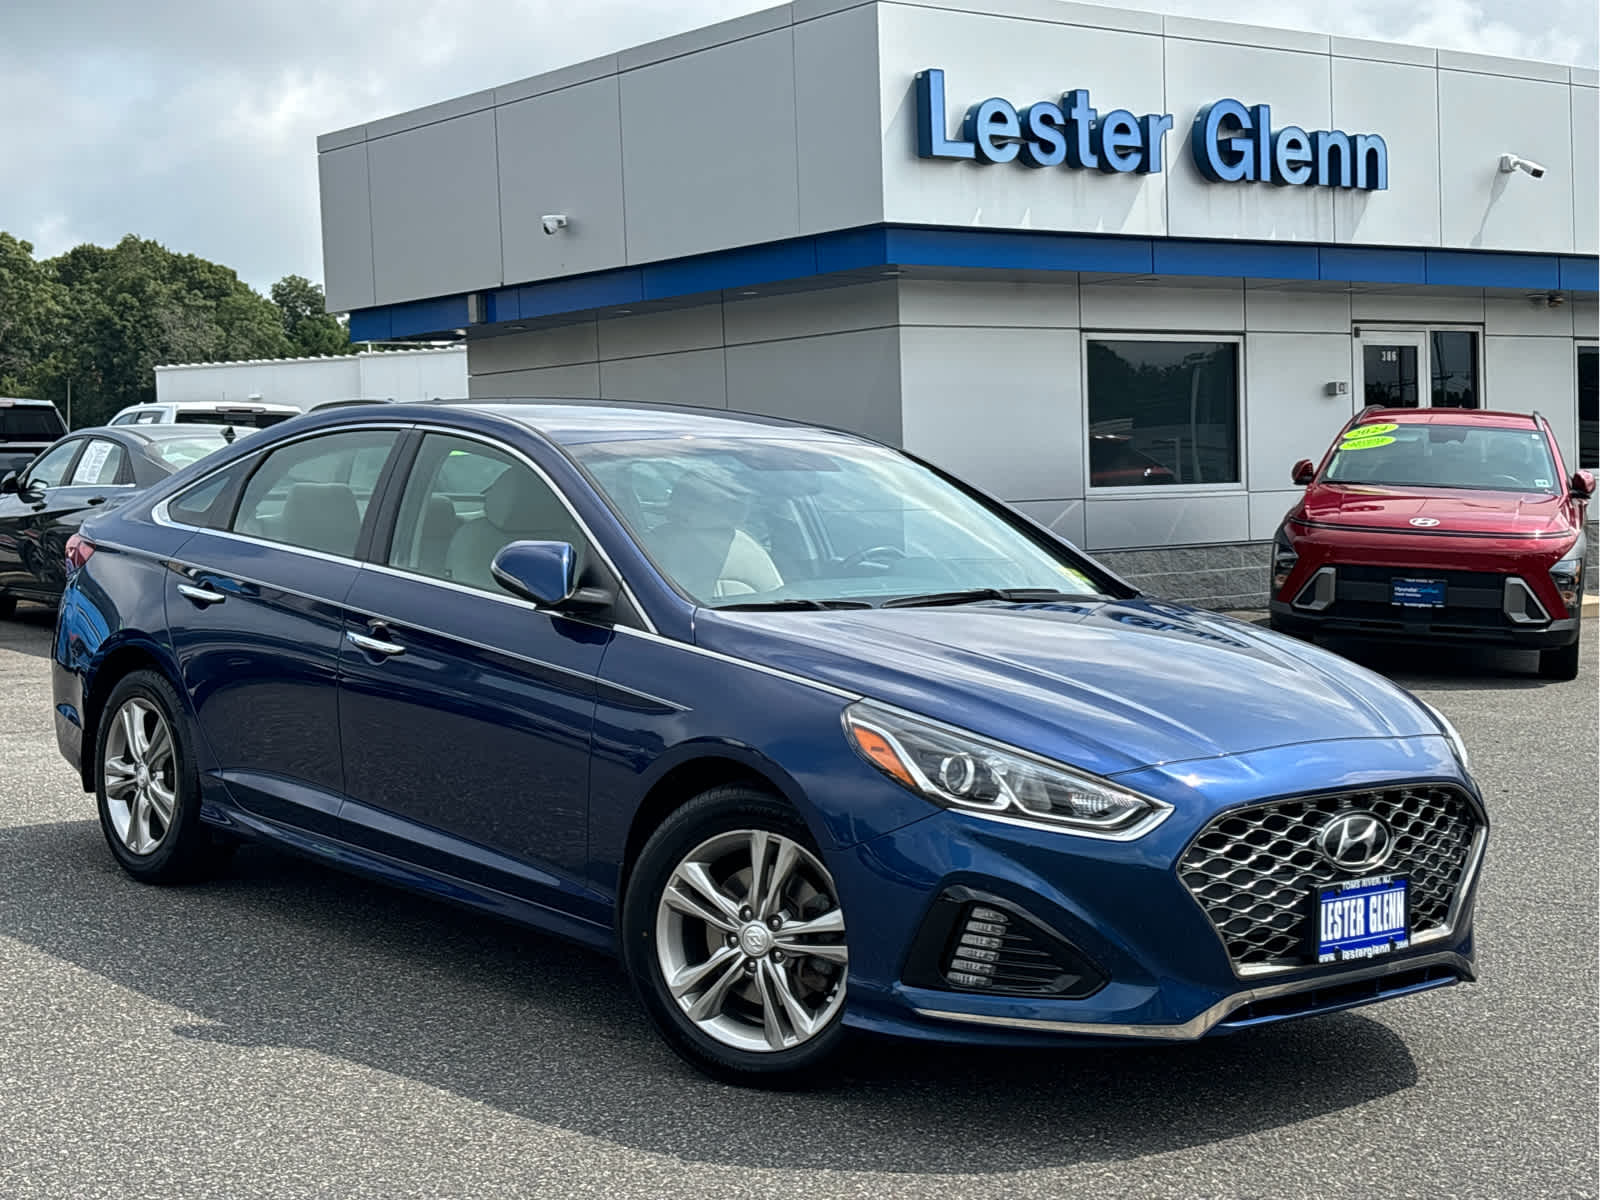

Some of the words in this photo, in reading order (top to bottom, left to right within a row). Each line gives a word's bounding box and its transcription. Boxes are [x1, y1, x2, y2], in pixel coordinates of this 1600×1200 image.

[916, 68, 1173, 175] Lester
[1191, 98, 1389, 190] Glenn
[1320, 898, 1365, 942] LESTER
[1369, 891, 1405, 933] GLENN
[1342, 944, 1390, 960] lesterglenn
